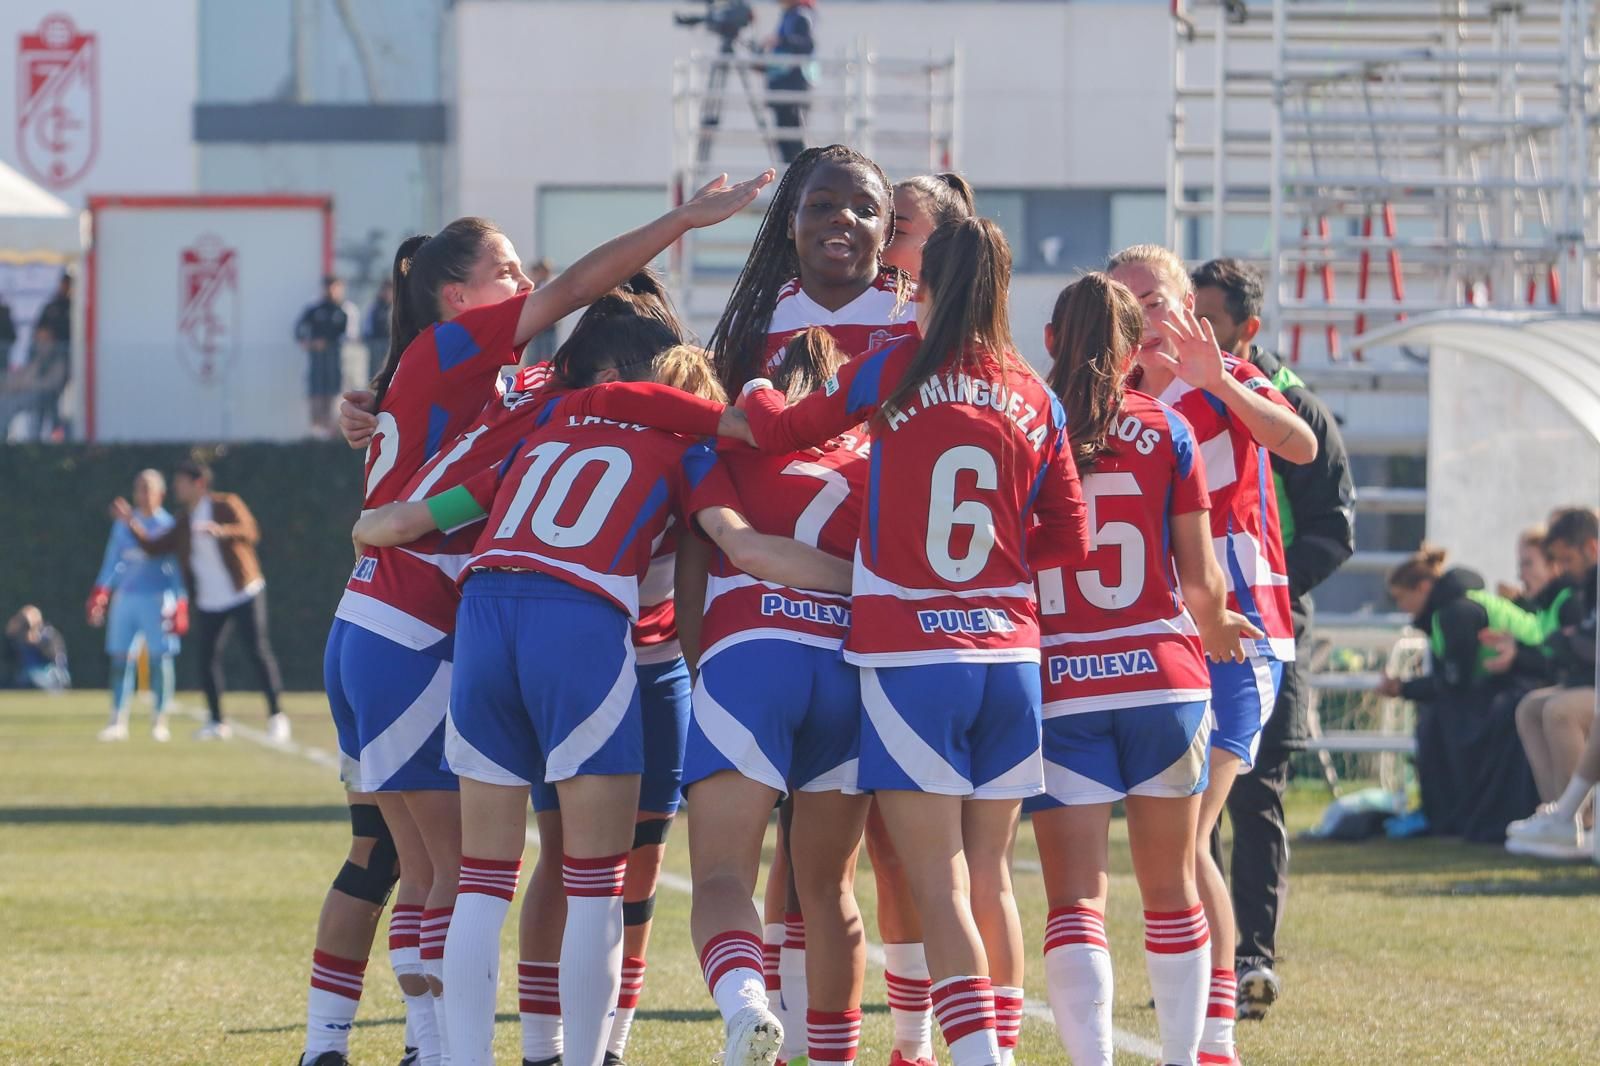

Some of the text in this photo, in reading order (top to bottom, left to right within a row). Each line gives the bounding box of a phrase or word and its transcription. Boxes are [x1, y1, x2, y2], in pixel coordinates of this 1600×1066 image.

[493, 441, 633, 548] 10
[780, 460, 851, 548] 7
[926, 445, 998, 582] 6
[761, 593, 851, 627] PULEV
[917, 608, 1016, 634] PULEVA
[1049, 648, 1157, 684] PULEVA
